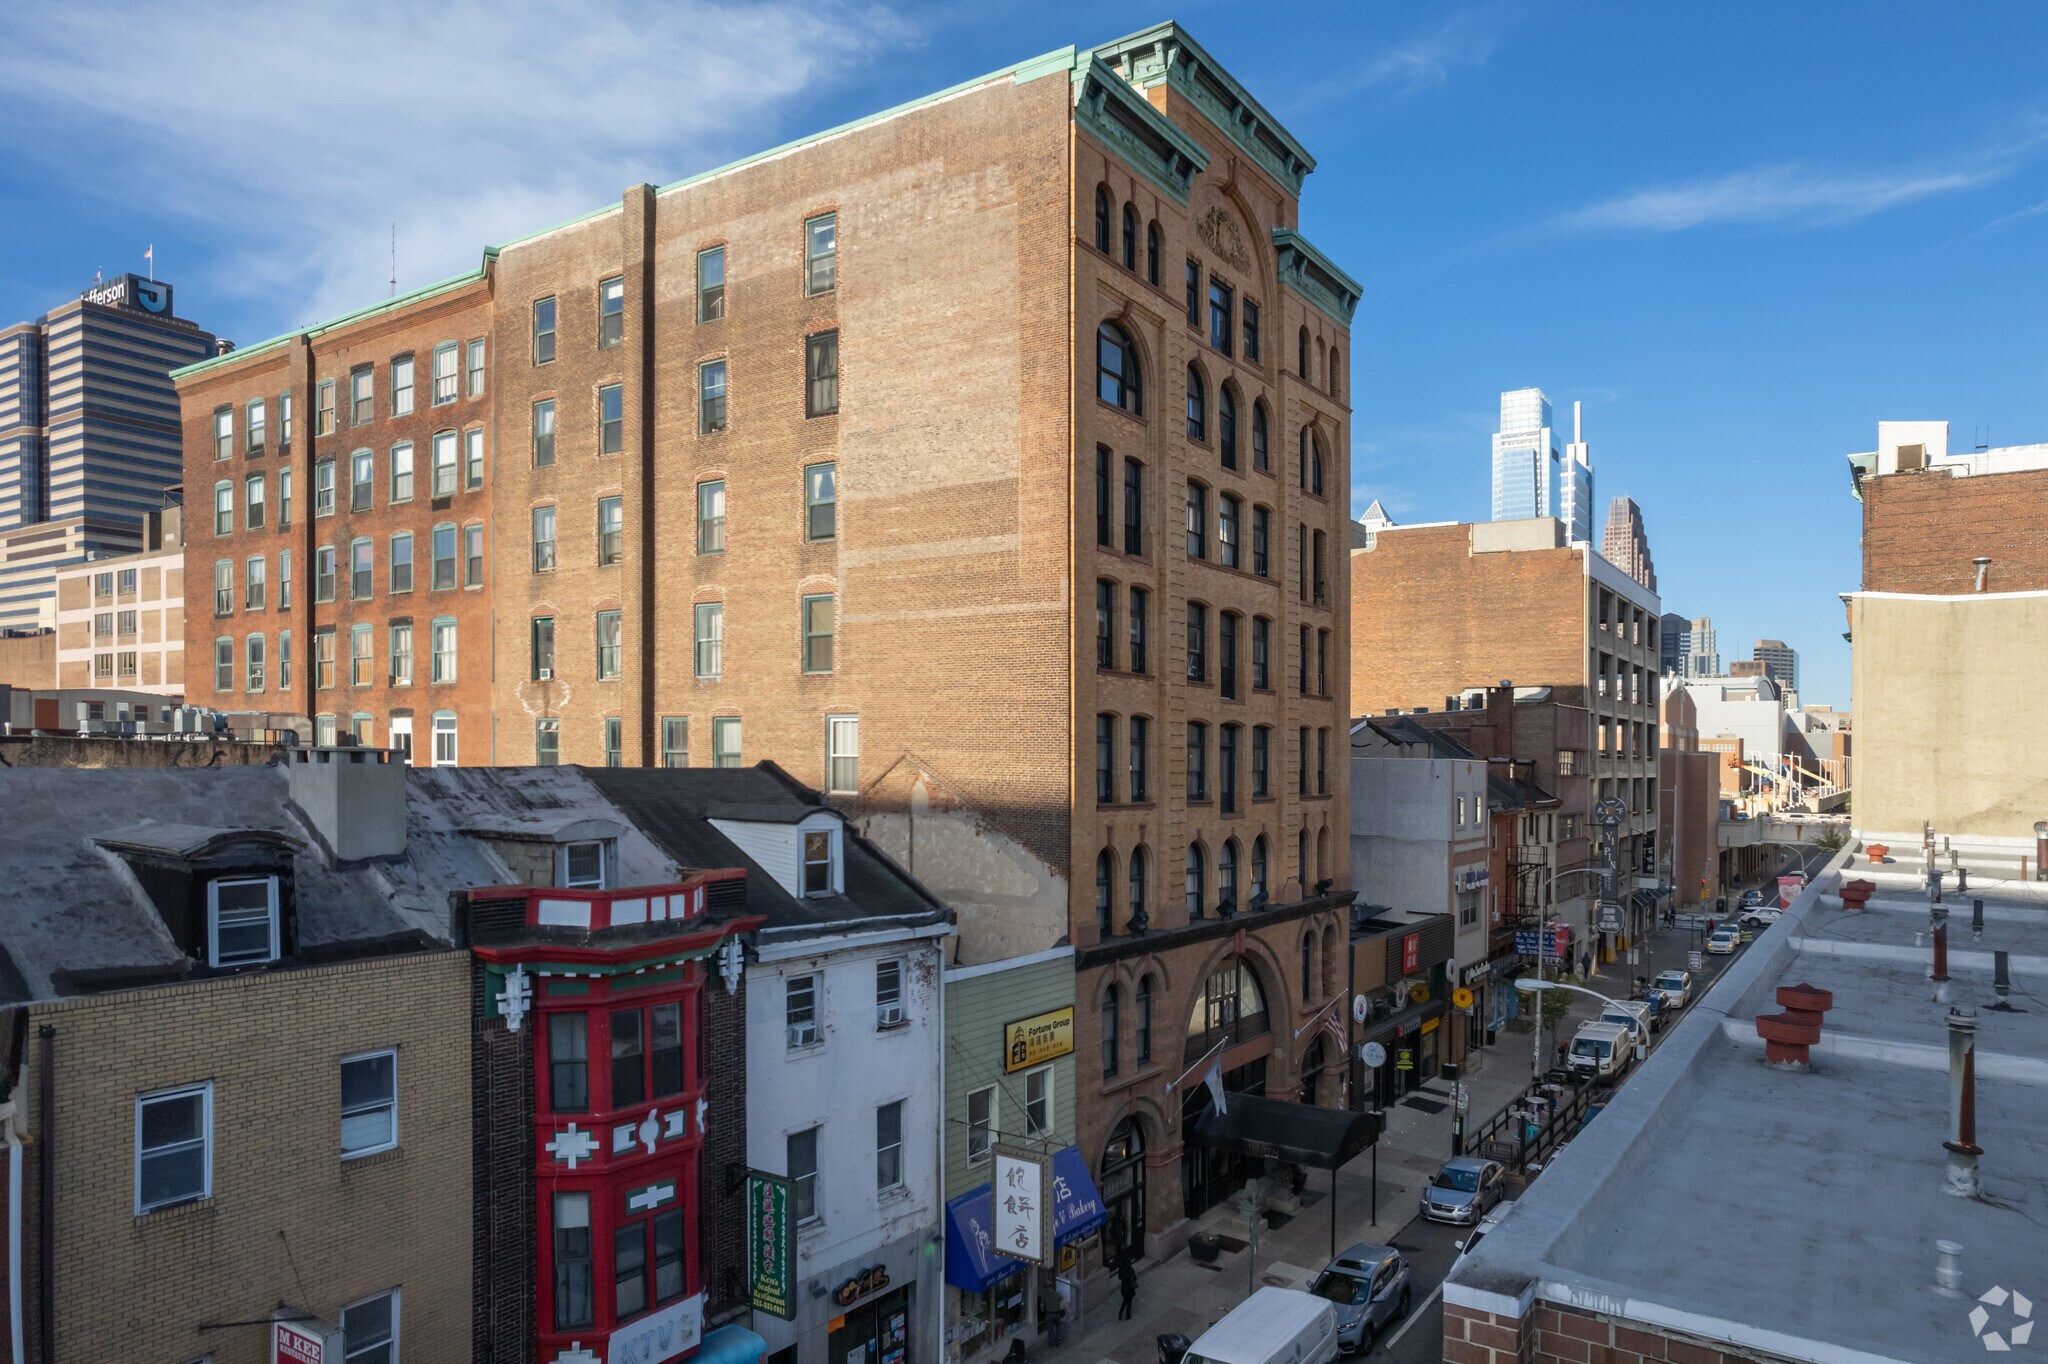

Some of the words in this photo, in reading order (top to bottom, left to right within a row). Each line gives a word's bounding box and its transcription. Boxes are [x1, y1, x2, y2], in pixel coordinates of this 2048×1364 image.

[1029, 1025, 1052, 1036] Fortune
[1053, 1018, 1070, 1030] Group
[1053, 1175, 1072, 1203] 店
[1068, 1199, 1097, 1221] Bakery
[757, 1281, 781, 1296] Seafood
[760, 1273, 779, 1287] Ken's
[753, 1288, 785, 1306] Restaurant
[278, 1328, 291, 1347] M
[293, 1335, 320, 1361] KEE
